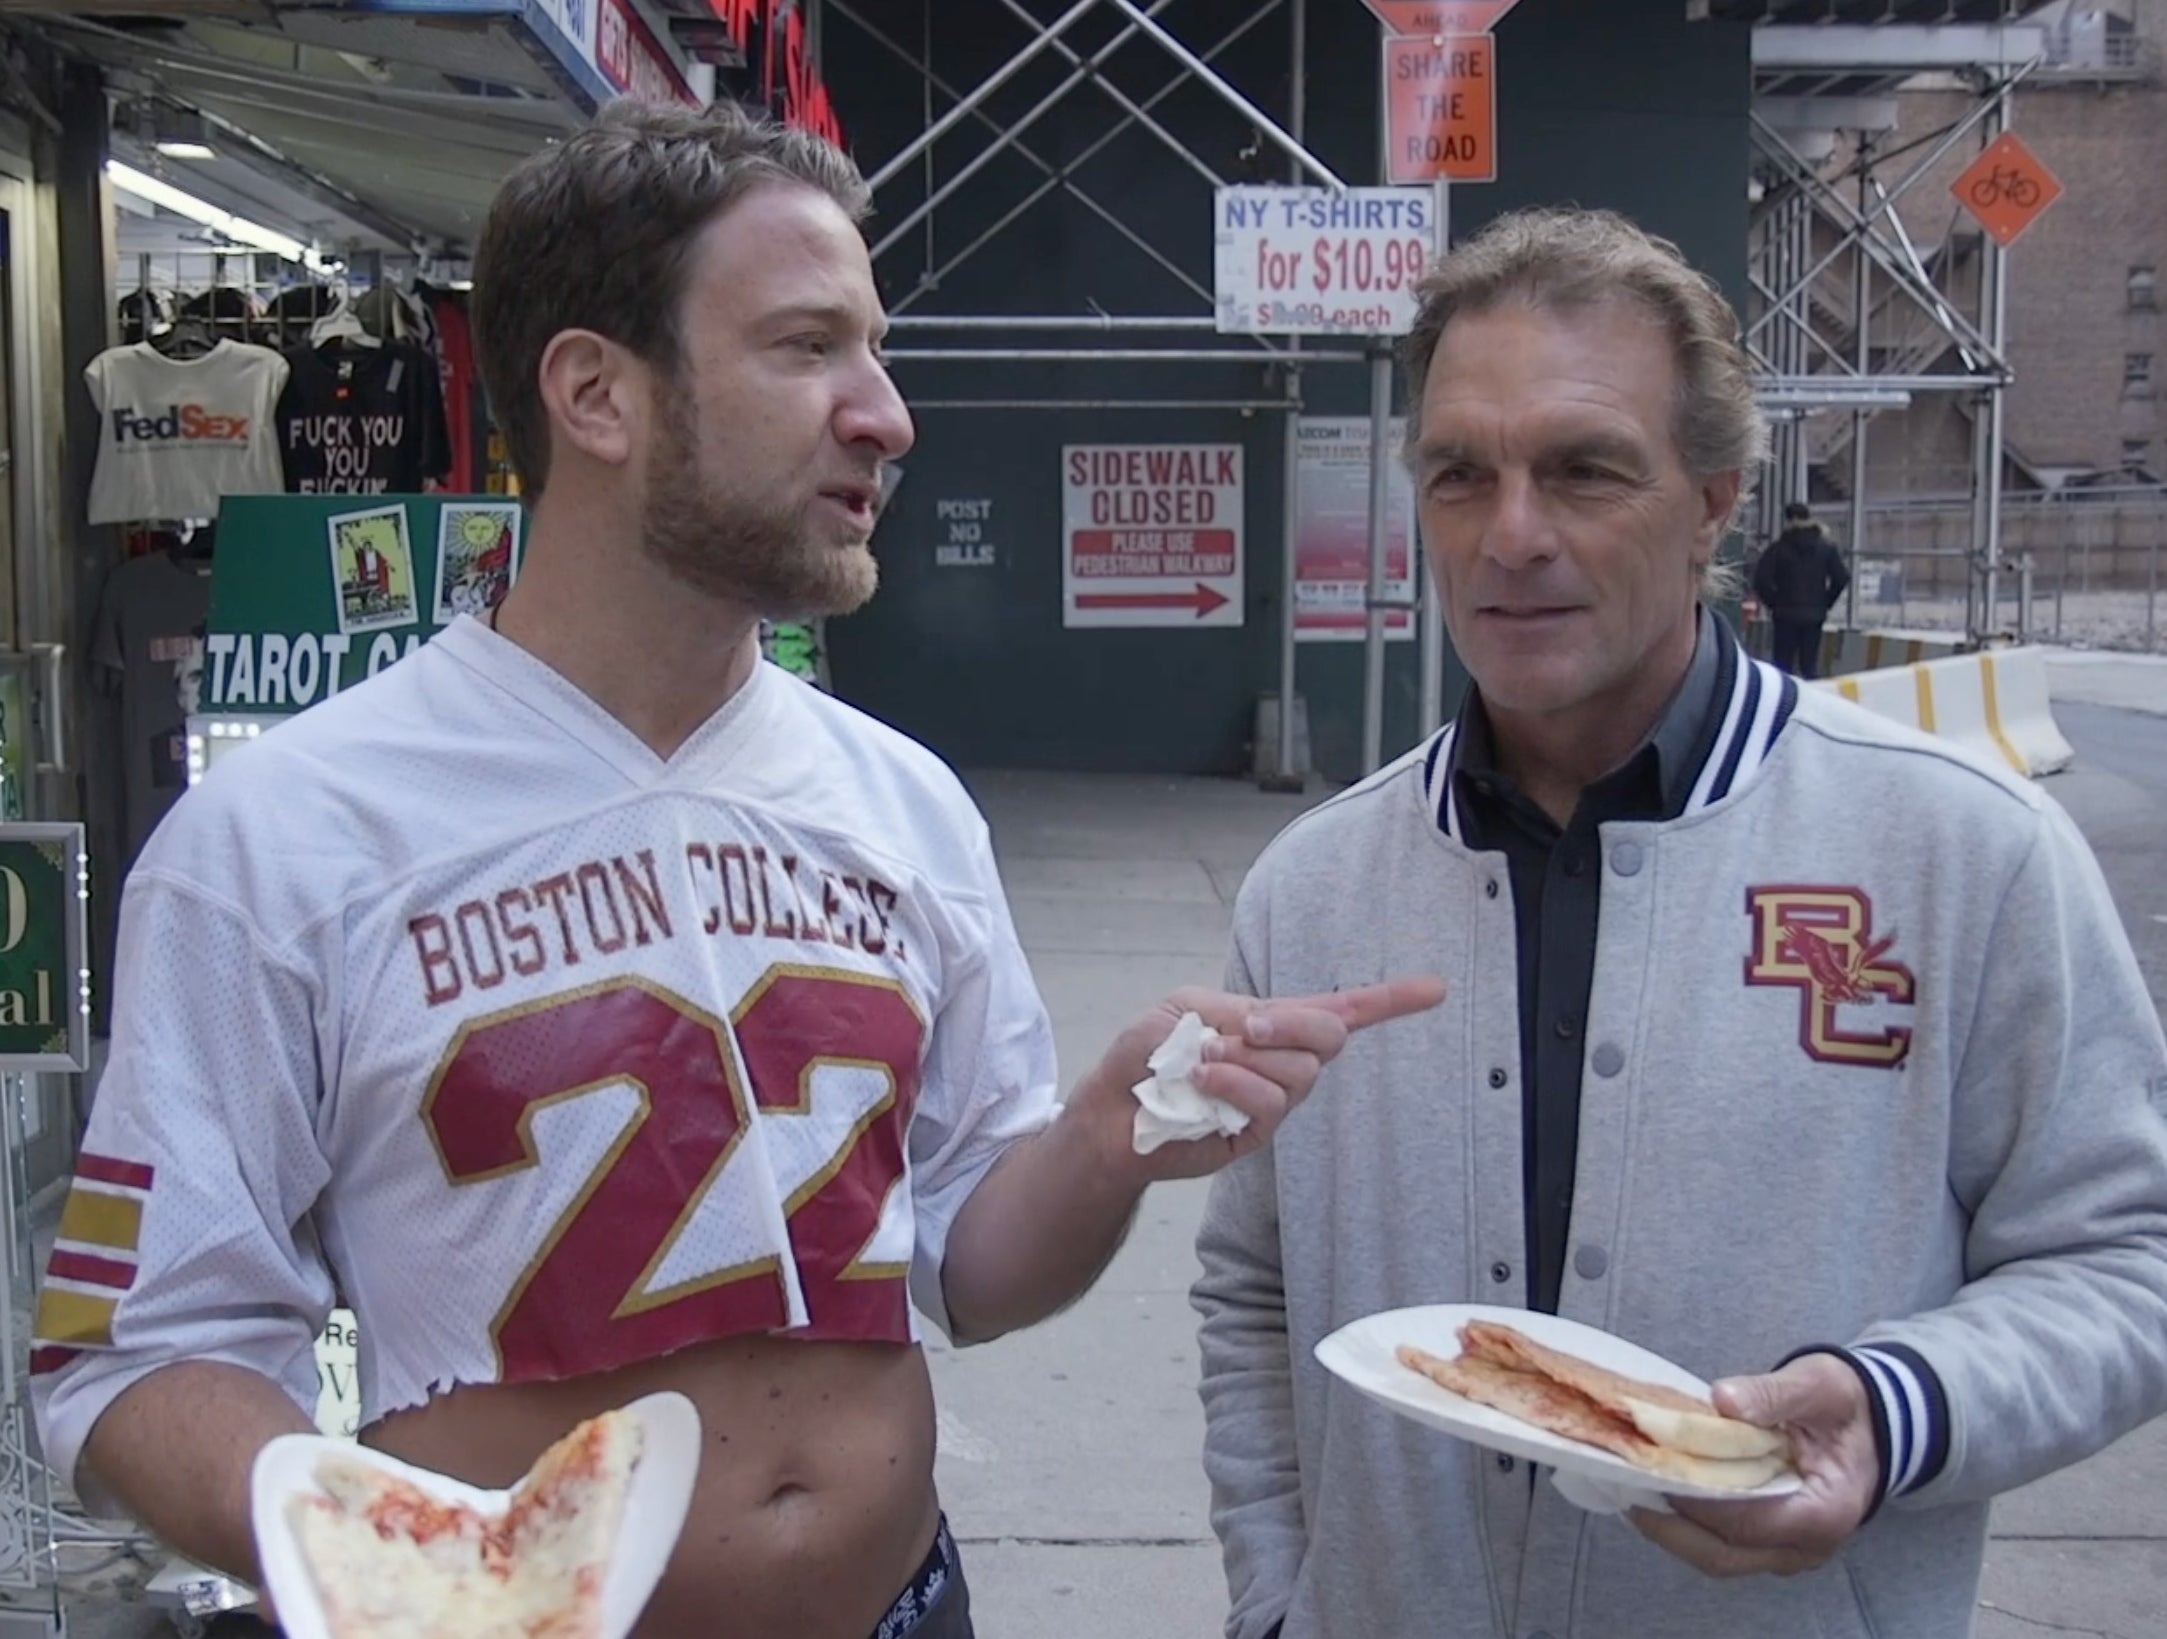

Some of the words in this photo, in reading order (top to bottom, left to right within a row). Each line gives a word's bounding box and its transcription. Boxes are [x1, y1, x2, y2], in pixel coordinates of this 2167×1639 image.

[1397, 51, 1483, 79] SHARE
[1416, 93, 1465, 121] THE
[1407, 134, 1476, 162] ROAD
[1226, 199, 1268, 228] NY
[1281, 199, 1425, 228] T-SHIRTS
[1258, 238, 1301, 290] for
[1313, 237, 1425, 295] $10.99
[1332, 305, 1391, 327] each
[289, 416, 353, 449] FUCK
[360, 416, 404, 447] YOU
[324, 447, 370, 479] YOU
[1069, 451, 1236, 486] SIDEWALK
[937, 500, 992, 519] POST
[1092, 490, 1214, 525] CLOSED
[949, 522, 981, 542] NO
[1112, 532, 1163, 551] PLEASE
[1167, 532, 1194, 551] USE
[936, 545, 995, 565] BILLS
[1075, 554, 1159, 574] PEDESTRIAN
[1164, 554, 1233, 574] WALKWAY
[207, 633, 350, 705] TAROT
[408, 849, 674, 1007] BOSTON
[419, 962, 930, 1384] 22
